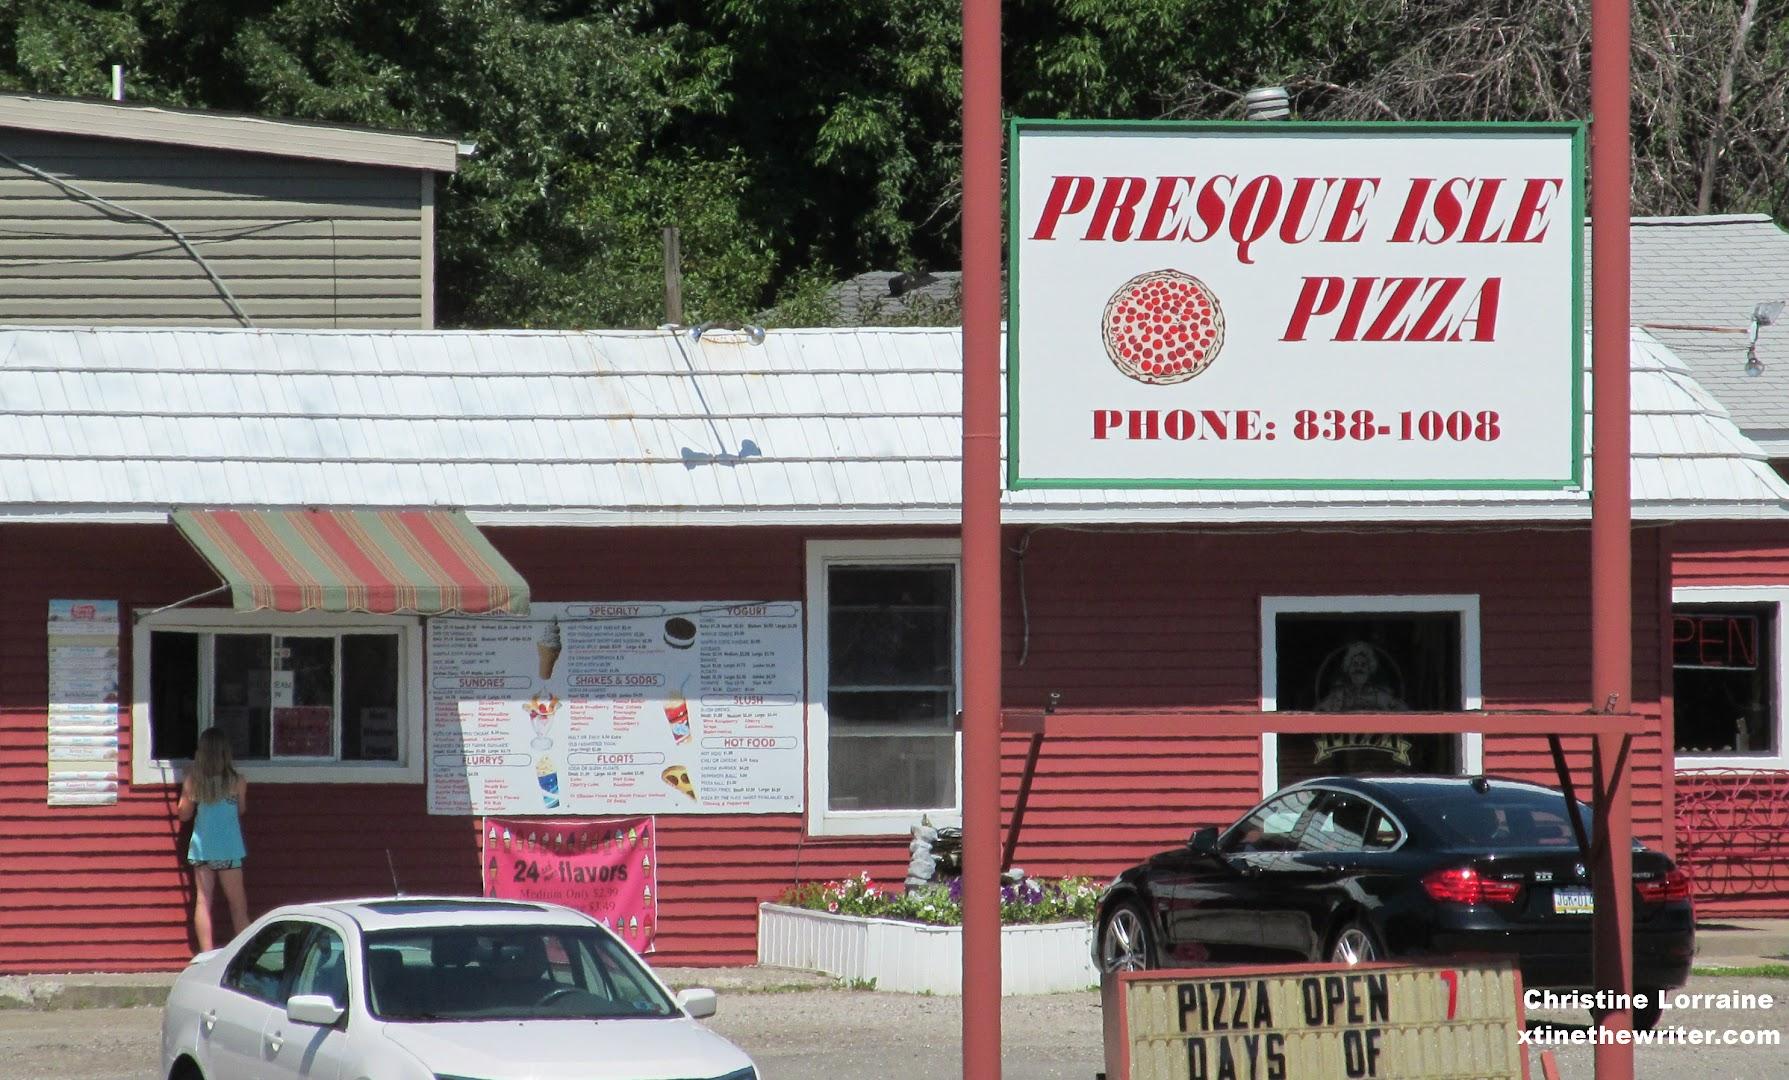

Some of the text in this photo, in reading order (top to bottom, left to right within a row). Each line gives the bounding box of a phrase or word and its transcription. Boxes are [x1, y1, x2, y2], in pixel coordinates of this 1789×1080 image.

[1028, 174, 1564, 264] PRESQUE ISLE
[1279, 276, 1502, 343] PIZZA
[1090, 408, 1501, 442] PHONE: 838-1008
[589, 607, 640, 616] SPECIALTY
[727, 607, 767, 616] YOGURT
[1673, 616, 1758, 666] PEN
[459, 679, 505, 688] SUNDAES
[575, 676, 658, 685] SHAKES & SODAS
[733, 695, 764, 704] SLUSH
[724, 739, 776, 747] HOT FOOD
[597, 755, 634, 763] FLOATS
[513, 860, 540, 883] 24
[558, 861, 628, 883] flavors
[520, 889, 561, 899] Medium
[1177, 970, 1458, 1032] PIZZA OPEN 7
[1188, 1029, 1382, 1080] DAYS OF
